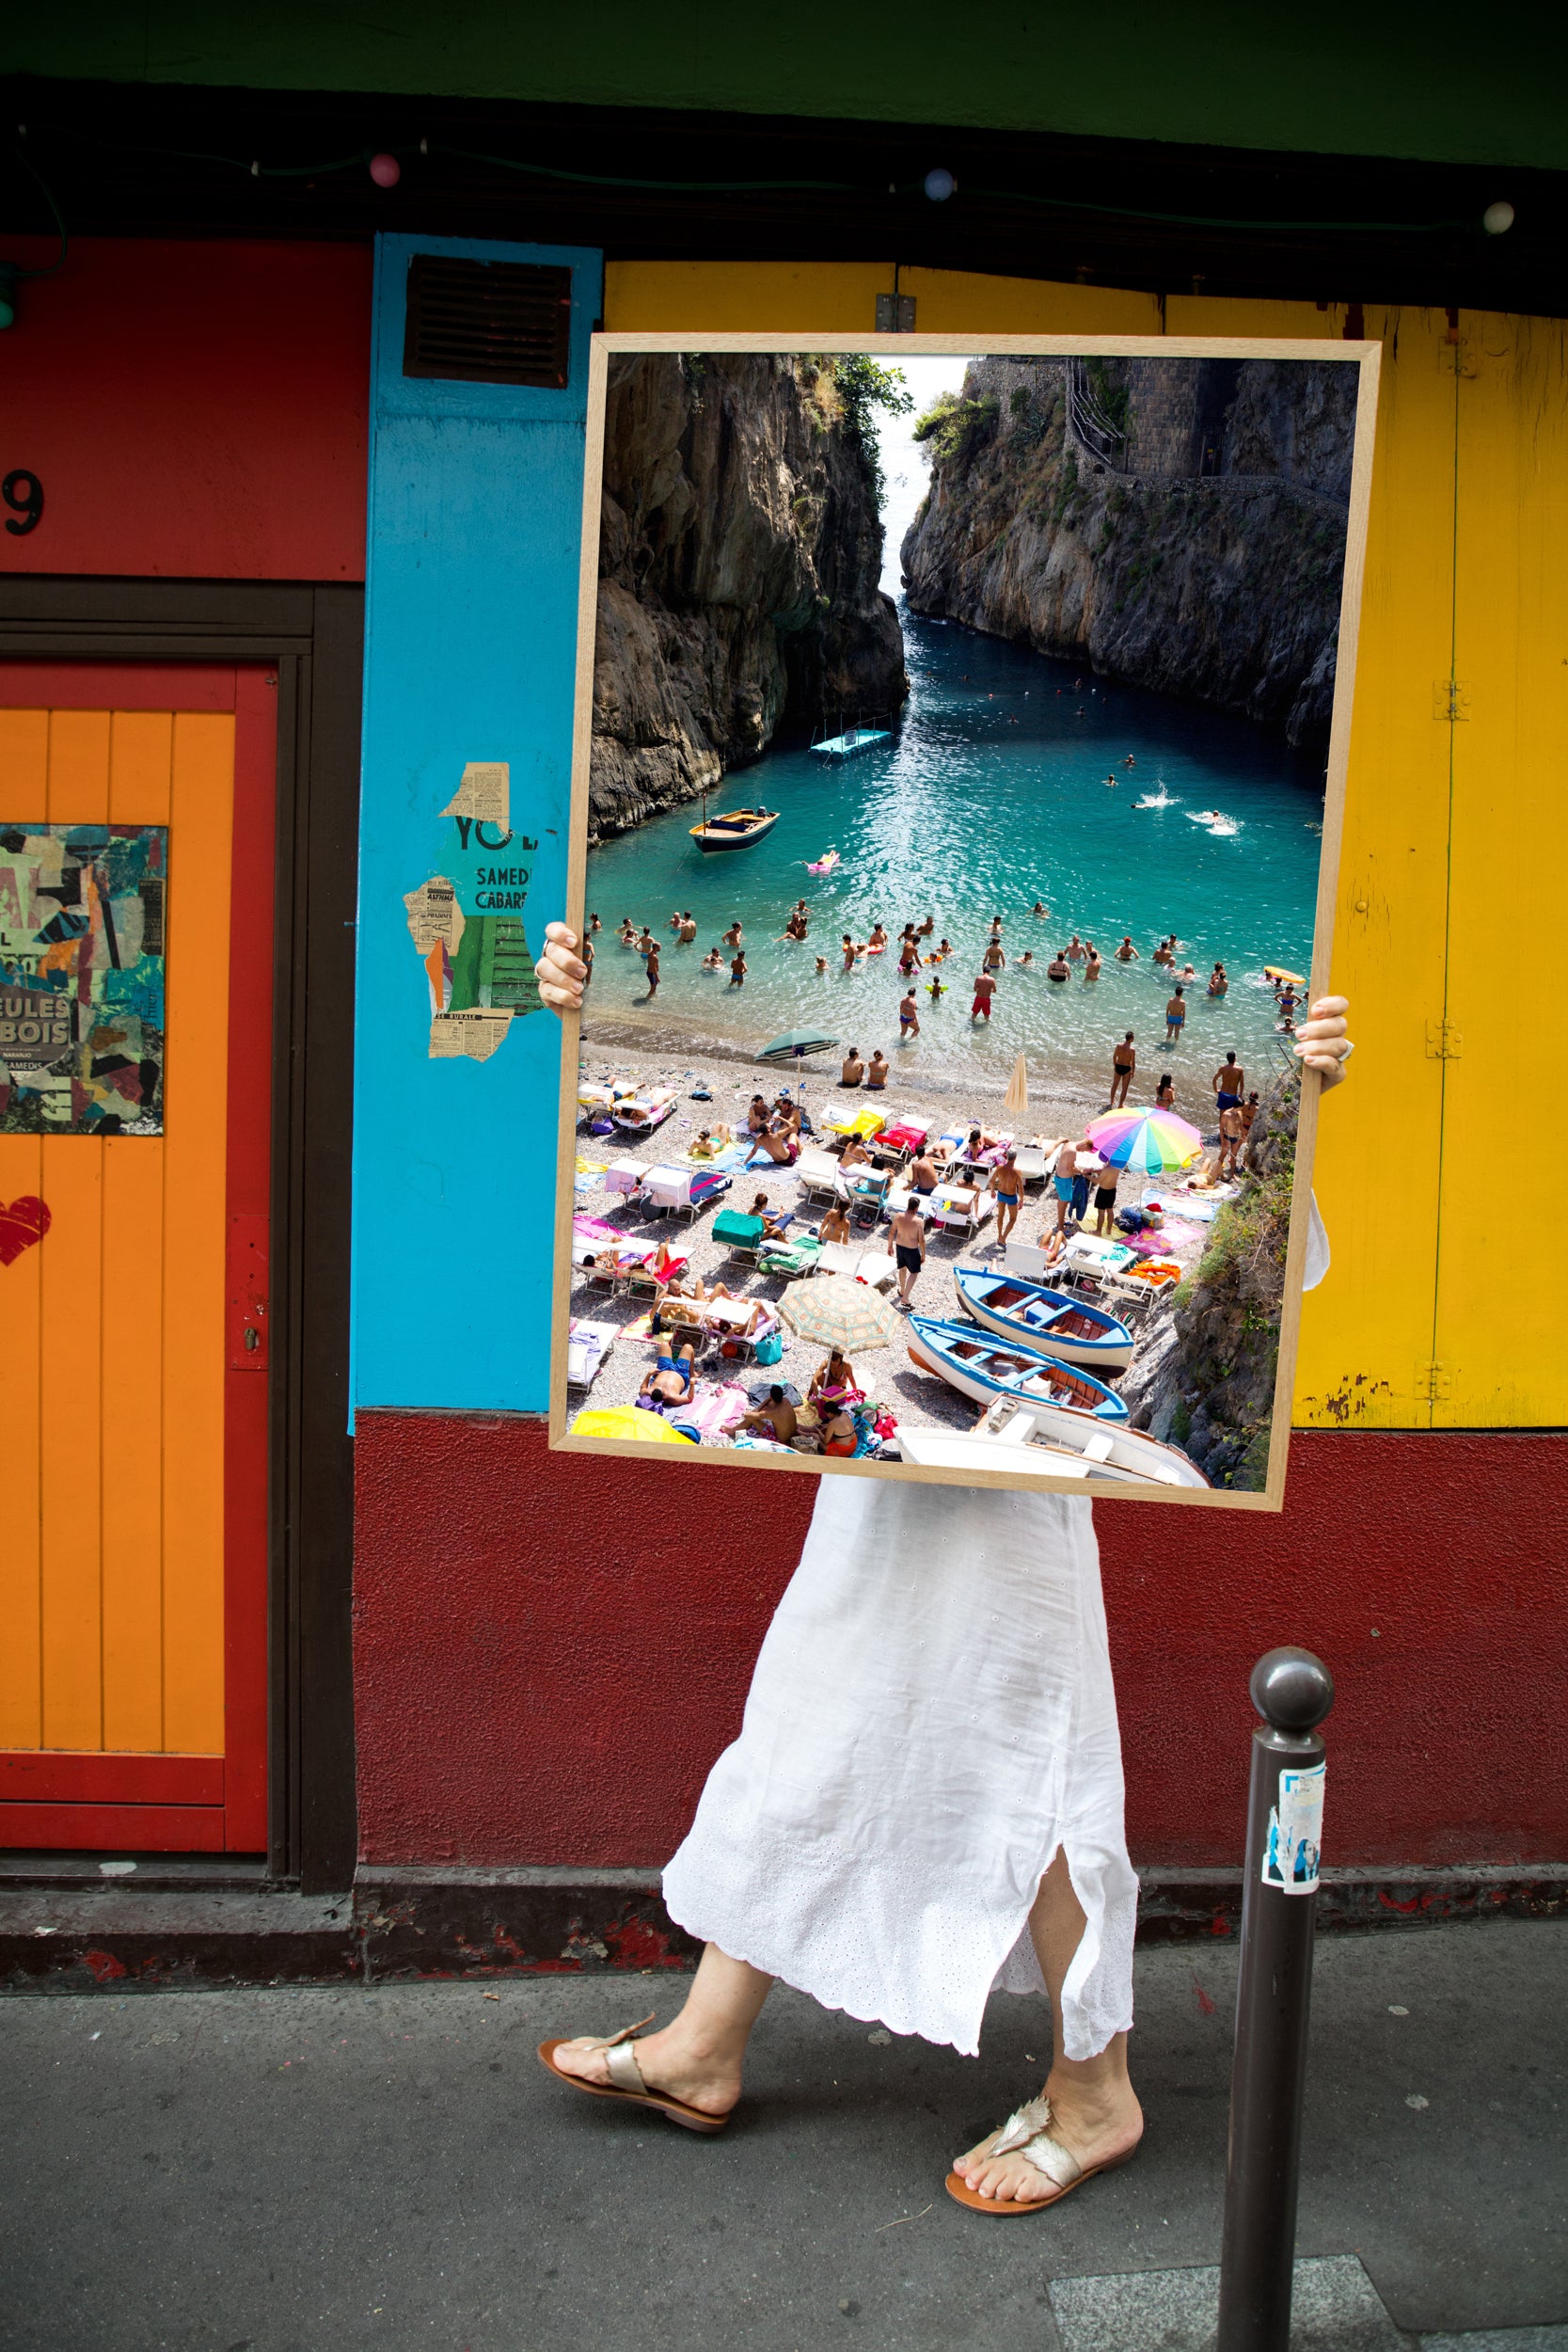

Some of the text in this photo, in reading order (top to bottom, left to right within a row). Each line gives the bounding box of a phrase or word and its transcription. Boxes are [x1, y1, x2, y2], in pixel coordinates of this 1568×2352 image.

[2, 469, 44, 535] 9
[0, 998, 69, 1019] ULES
[0, 1021, 69, 1044] BOIS
